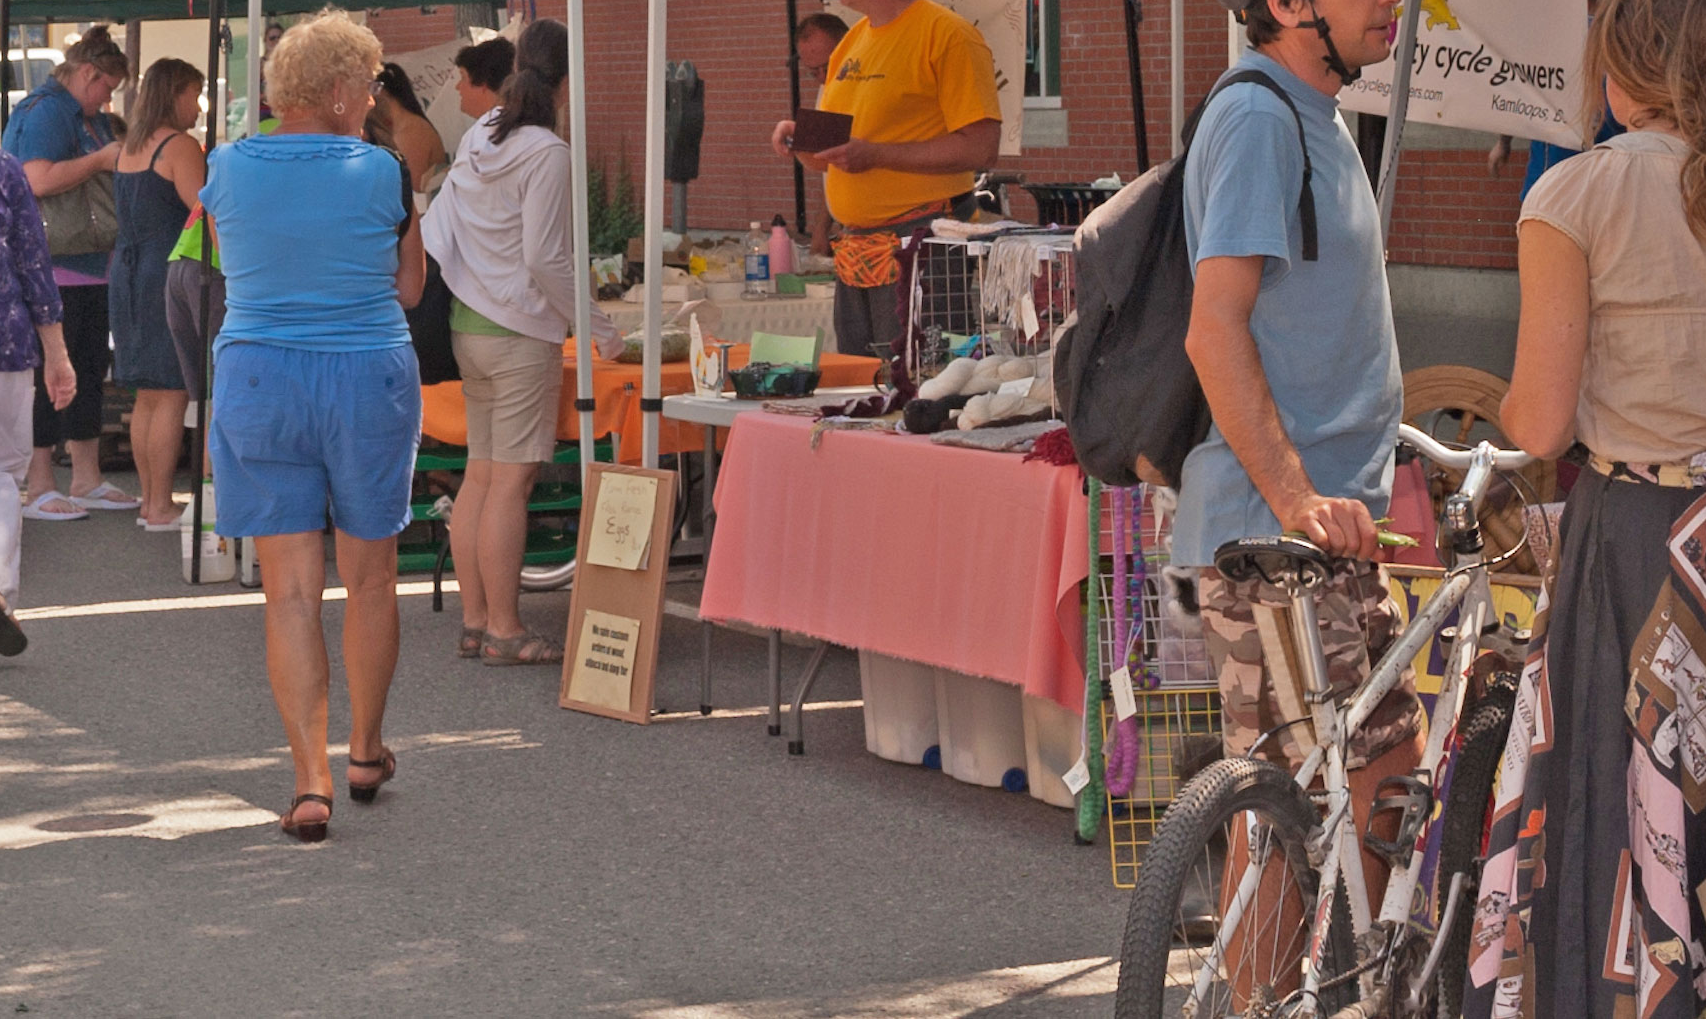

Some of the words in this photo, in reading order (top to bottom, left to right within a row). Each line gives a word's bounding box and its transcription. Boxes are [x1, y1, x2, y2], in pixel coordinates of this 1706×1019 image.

[1435, 44, 1493, 78] cycle
[1490, 59, 1565, 91] growers
[1492, 94, 1550, 122] Kamloops,
[606, 516, 631, 544] Eggs
